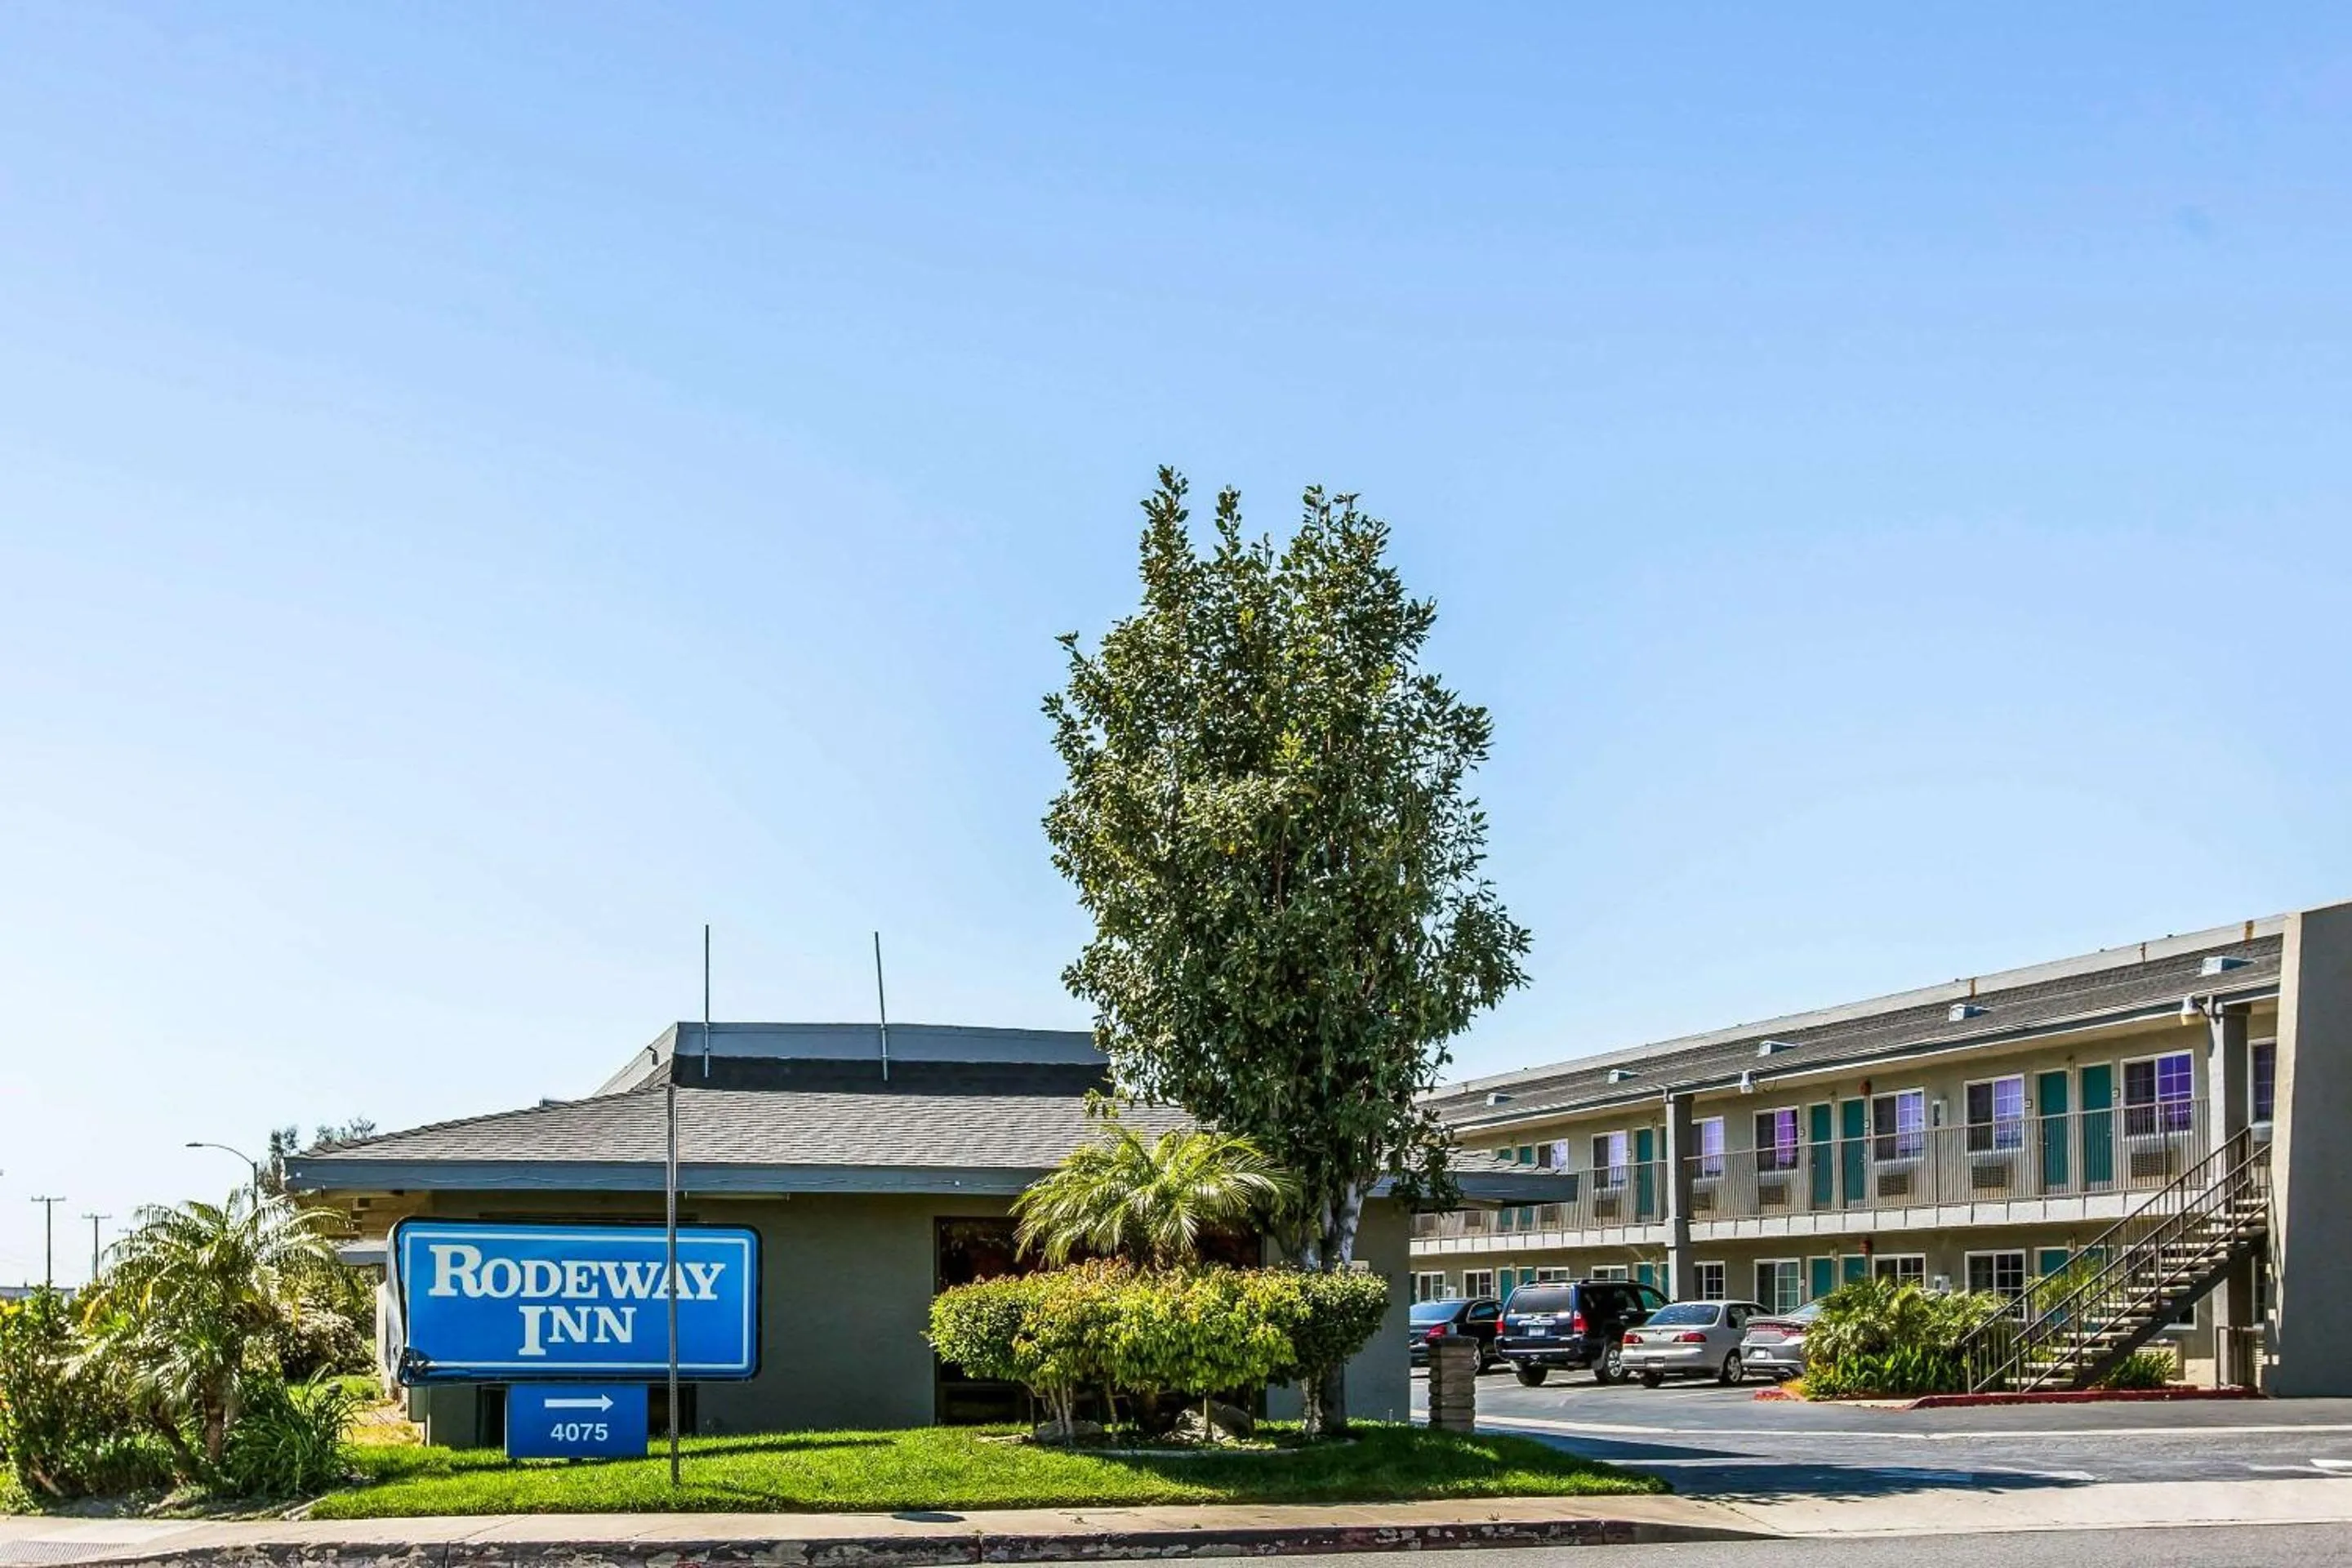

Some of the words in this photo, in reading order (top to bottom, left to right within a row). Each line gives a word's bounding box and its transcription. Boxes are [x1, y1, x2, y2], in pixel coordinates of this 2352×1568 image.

[427, 1243, 726, 1300] RODEWAY
[518, 1305, 637, 1356] INN
[550, 1423, 608, 1442] 4075
